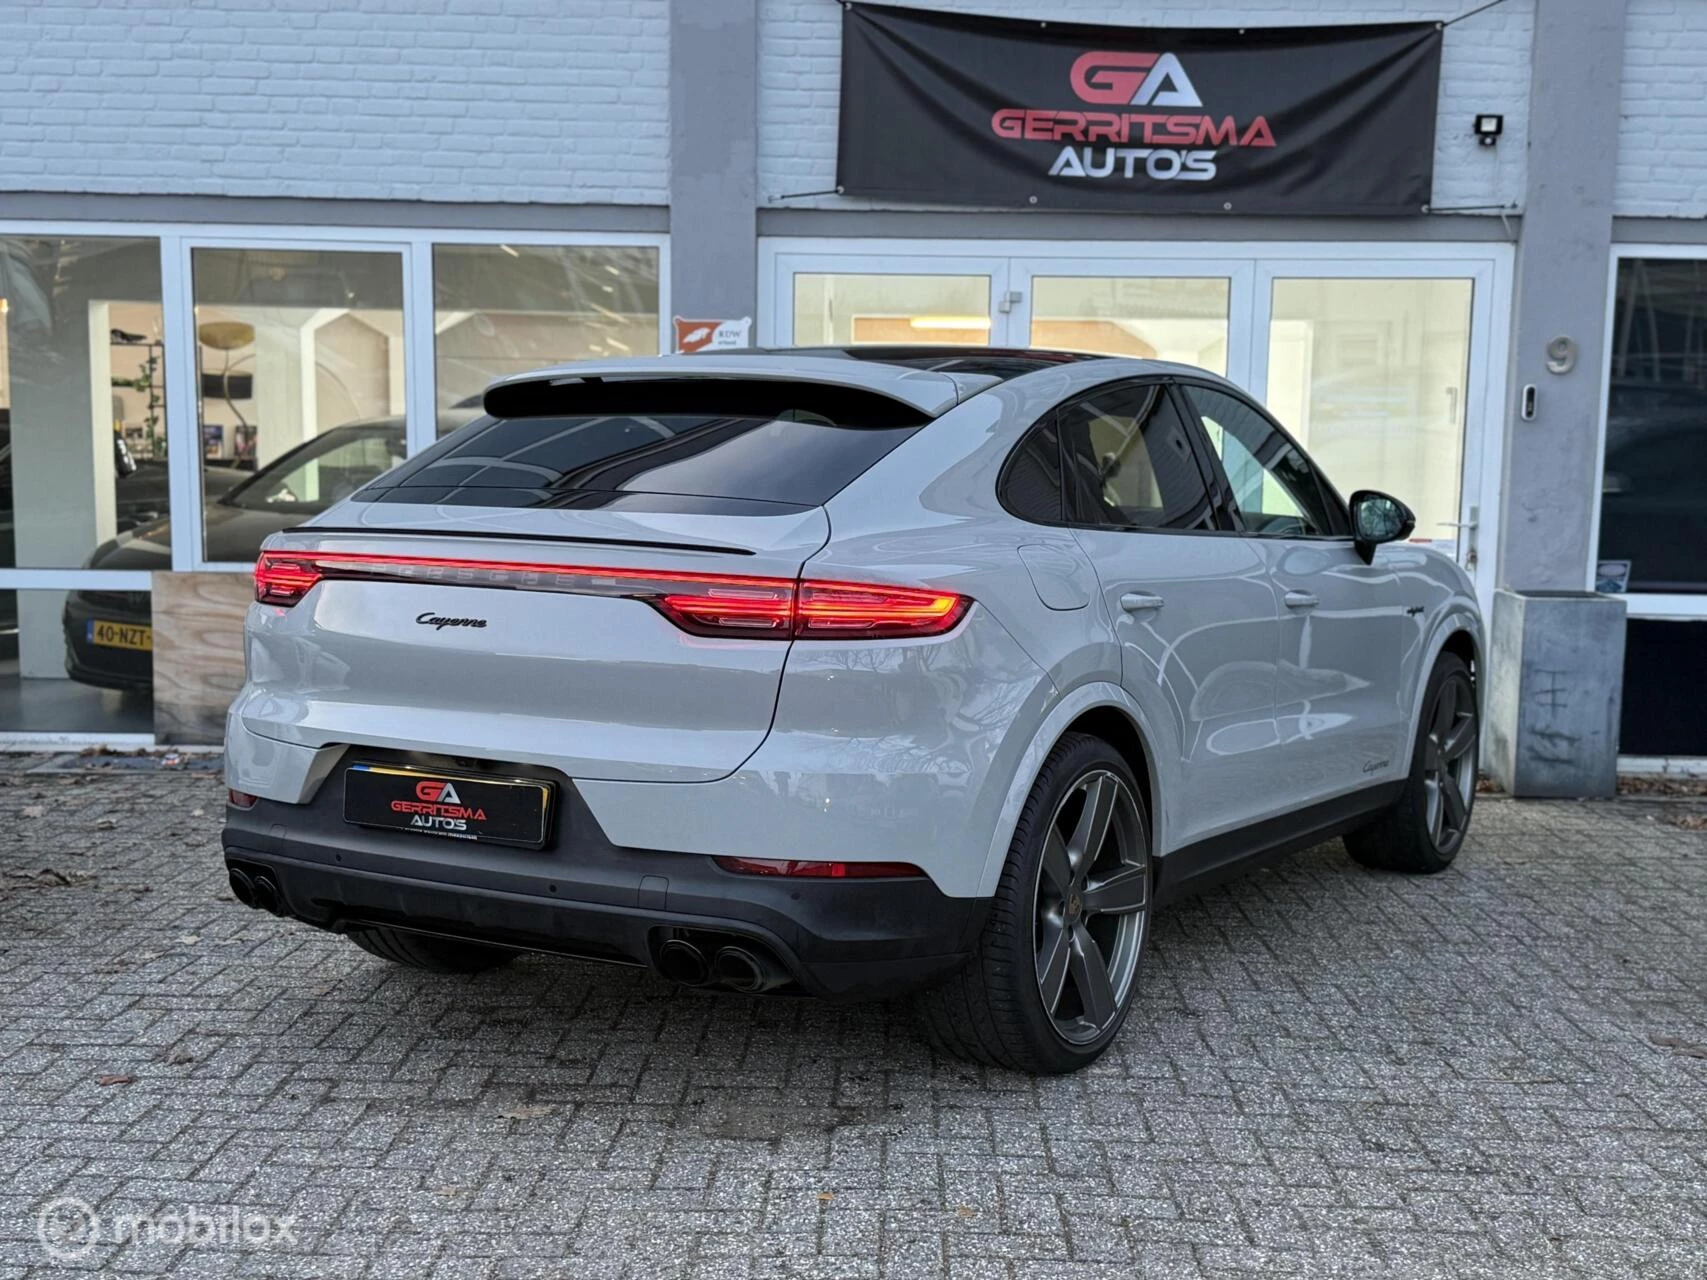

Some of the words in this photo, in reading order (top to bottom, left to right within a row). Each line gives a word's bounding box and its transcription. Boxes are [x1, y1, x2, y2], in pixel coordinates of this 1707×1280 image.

[1070, 51, 1203, 107] GA
[991, 108, 1277, 147] GERRITSMA
[1048, 146, 1217, 181] AUTO'S
[1546, 336, 1576, 374] 9
[416, 612, 487, 630] Cayenne
[97, 623, 151, 647] 40-NZT-
[416, 781, 461, 804] GA
[391, 801, 487, 821] GERRITSMA
[410, 815, 467, 831] AUTO'S
